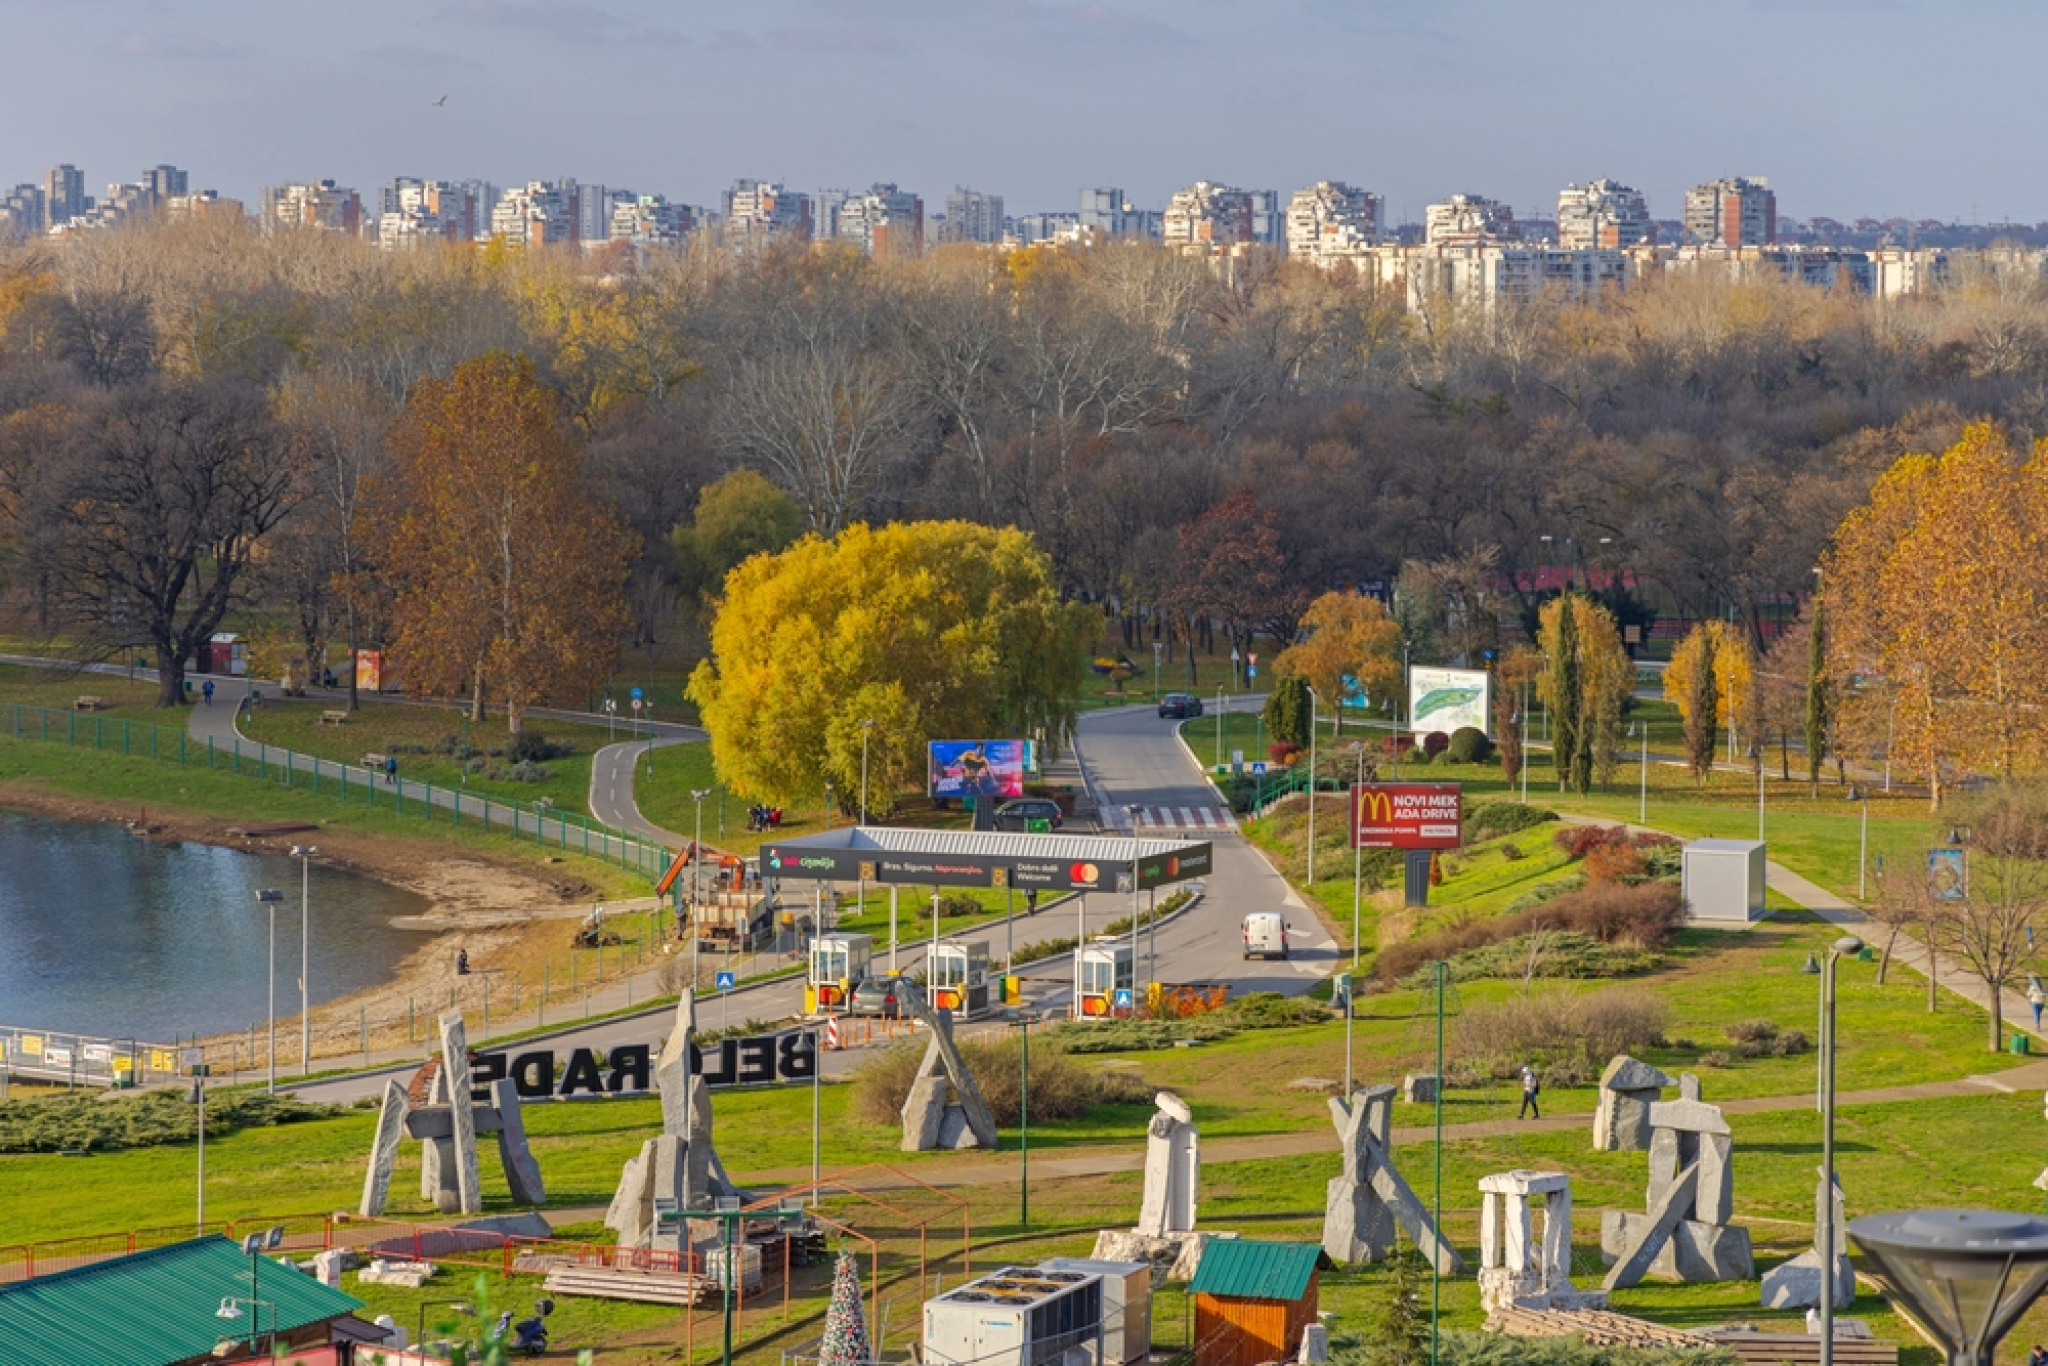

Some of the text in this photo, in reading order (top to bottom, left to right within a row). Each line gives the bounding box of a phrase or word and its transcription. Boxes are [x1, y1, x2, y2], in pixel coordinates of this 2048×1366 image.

[1394, 795, 1457, 807] NOVI MEK
[1394, 808, 1457, 819] ADA DRIVE
[1017, 872, 1051, 881] Welcome
